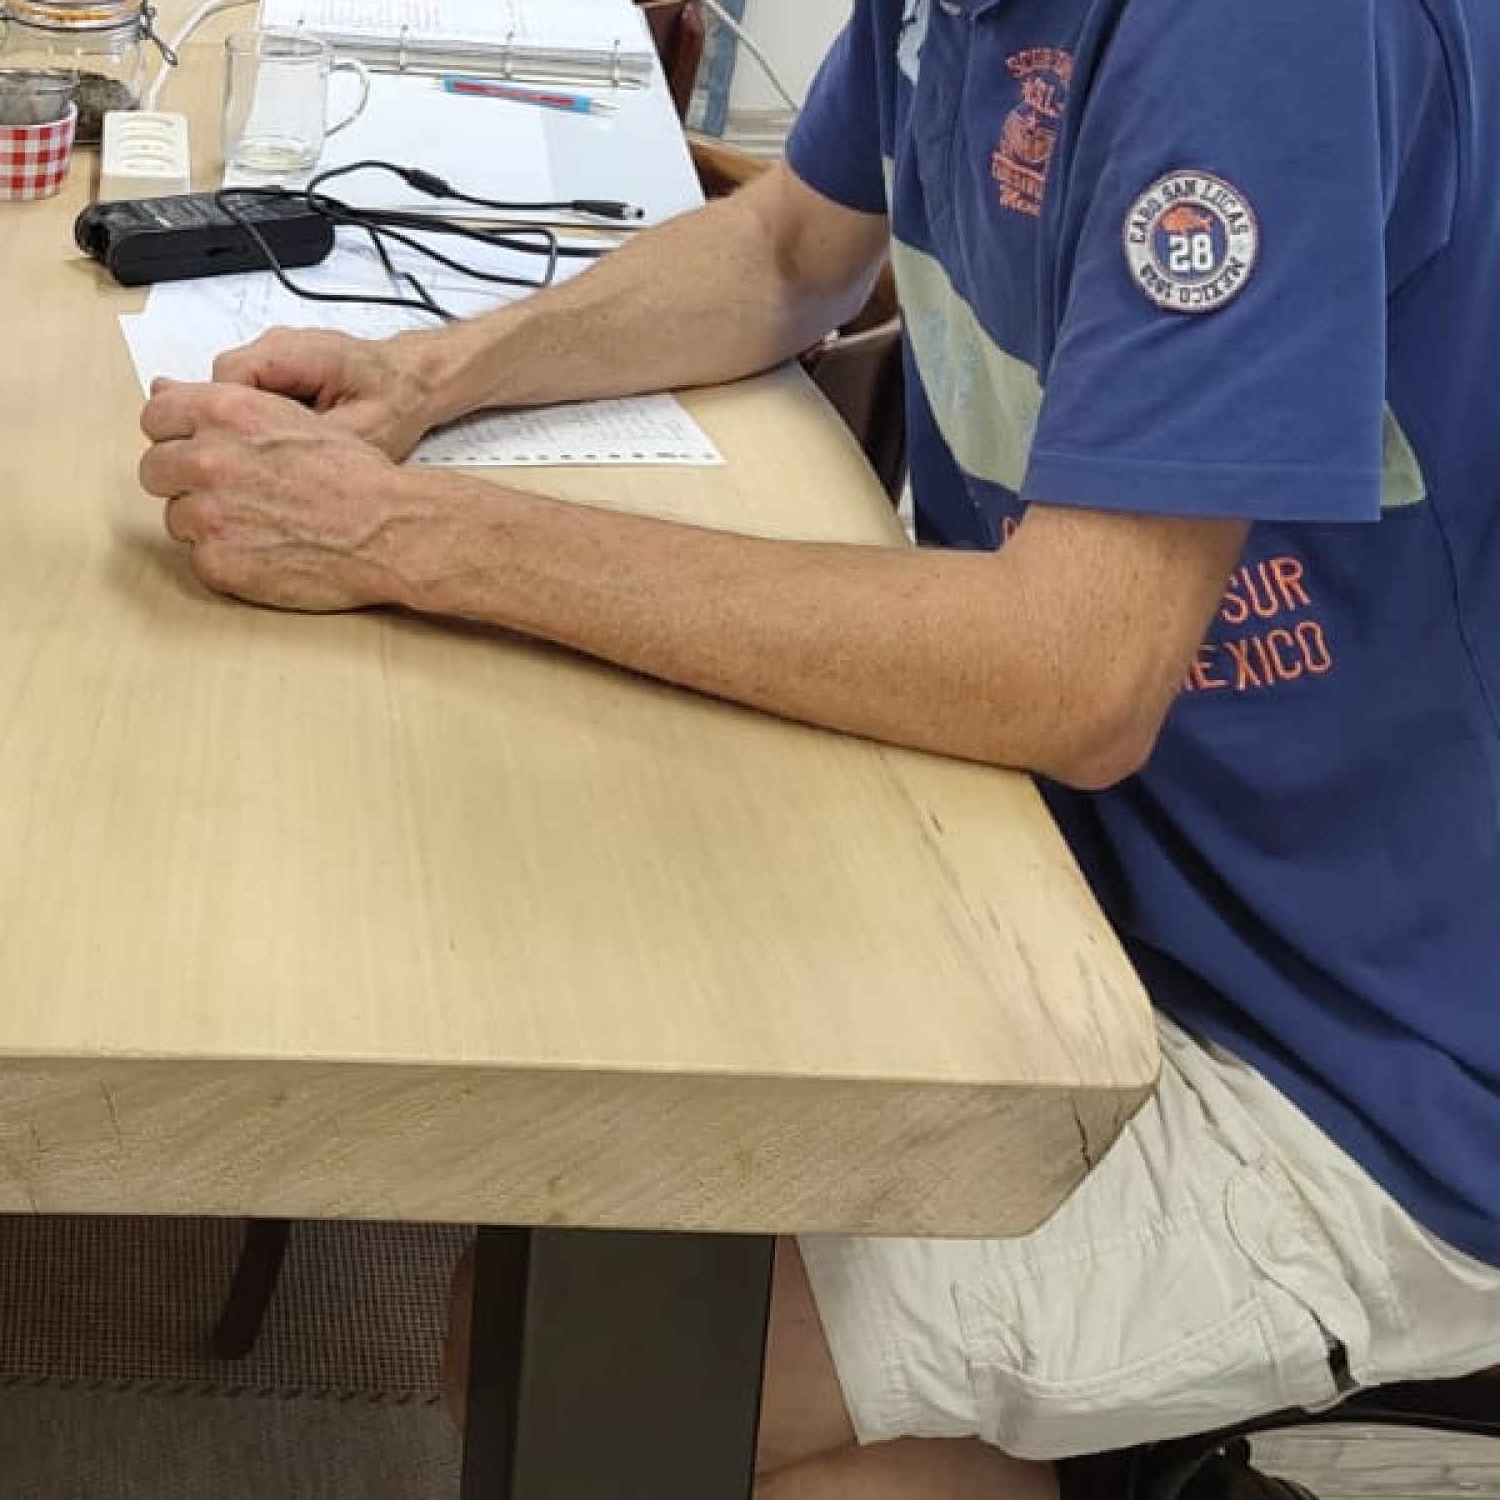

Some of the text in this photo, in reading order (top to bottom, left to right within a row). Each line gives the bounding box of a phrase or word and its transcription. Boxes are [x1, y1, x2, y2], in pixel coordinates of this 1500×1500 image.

[1162, 179, 1197, 202] SAN
[1169, 234, 1215, 271] 28
[1220, 556, 1312, 624] SUR
[1184, 619, 1333, 691] EXICO
